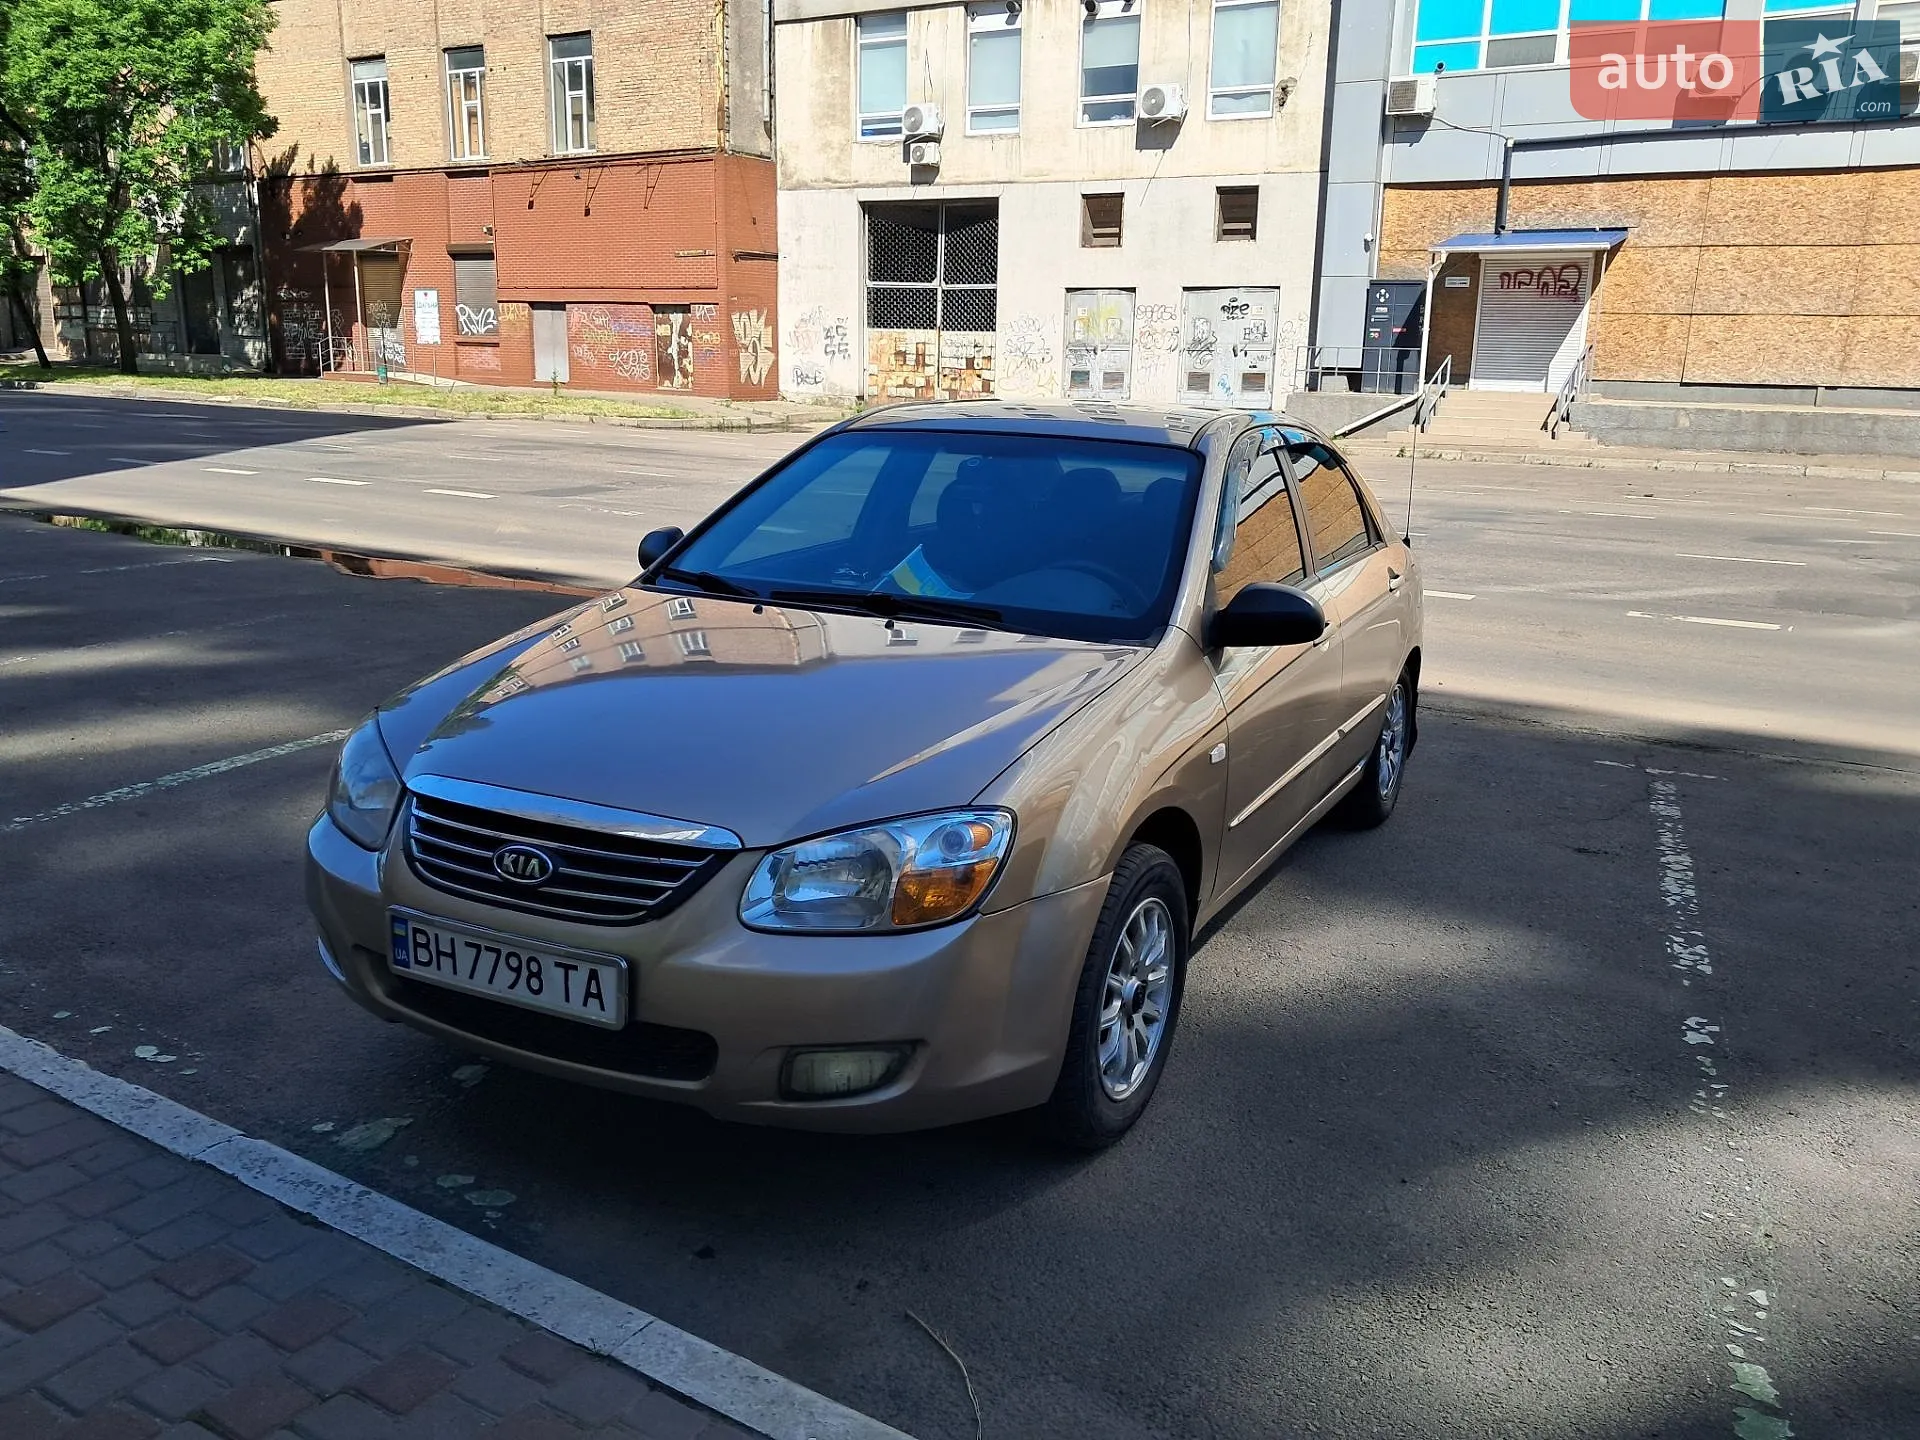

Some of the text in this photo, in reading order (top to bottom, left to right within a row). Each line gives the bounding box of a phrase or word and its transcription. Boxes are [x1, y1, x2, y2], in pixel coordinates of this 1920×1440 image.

[502, 852, 541, 878] KIA
[394, 948, 408, 962] UA
[412, 926, 606, 1012] BH 7798 TA
